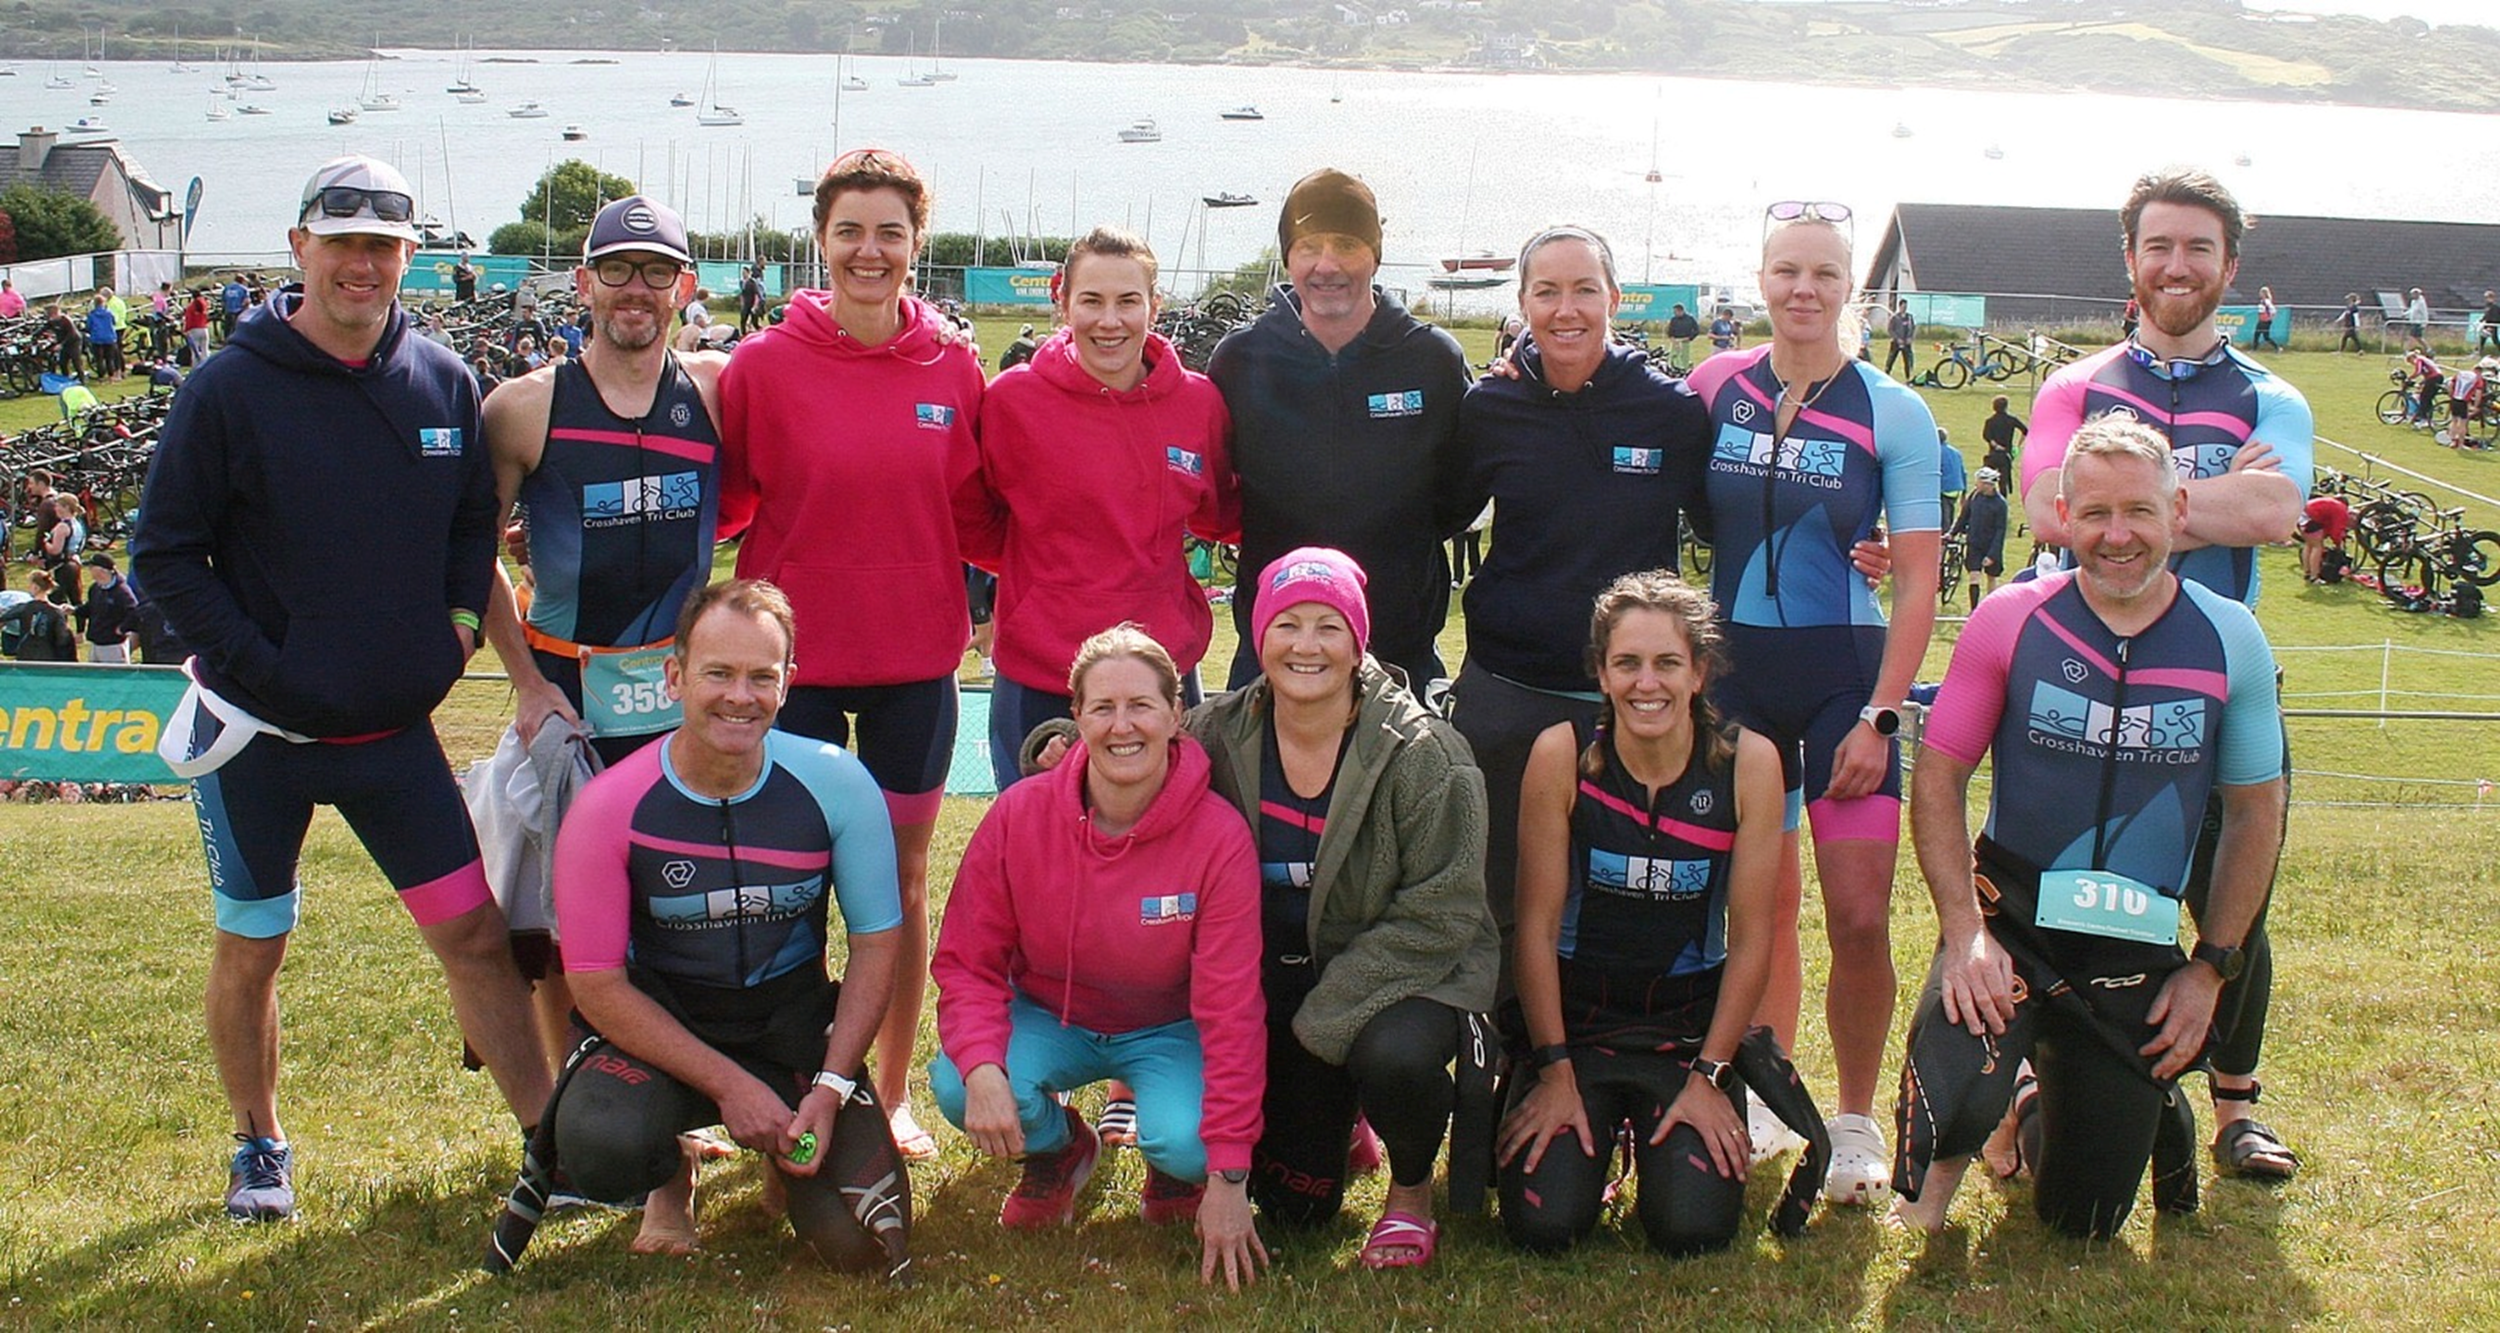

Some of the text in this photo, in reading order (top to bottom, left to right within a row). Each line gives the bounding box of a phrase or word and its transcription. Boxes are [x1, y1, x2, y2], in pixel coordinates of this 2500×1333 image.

[1790, 471, 1807, 483] Tri
[1809, 475, 1842, 489] Club
[583, 508, 695, 528] Crosshaven Tri Club
[612, 679, 673, 715] 358
[2137, 750, 2161, 763] Tri
[2166, 749, 2200, 764] Club
[200, 818, 216, 843] Tri
[207, 844, 224, 887] Club
[1654, 892, 1669, 901] Tri
[1672, 891, 1700, 901] Club
[2073, 878, 2148, 915] 310
